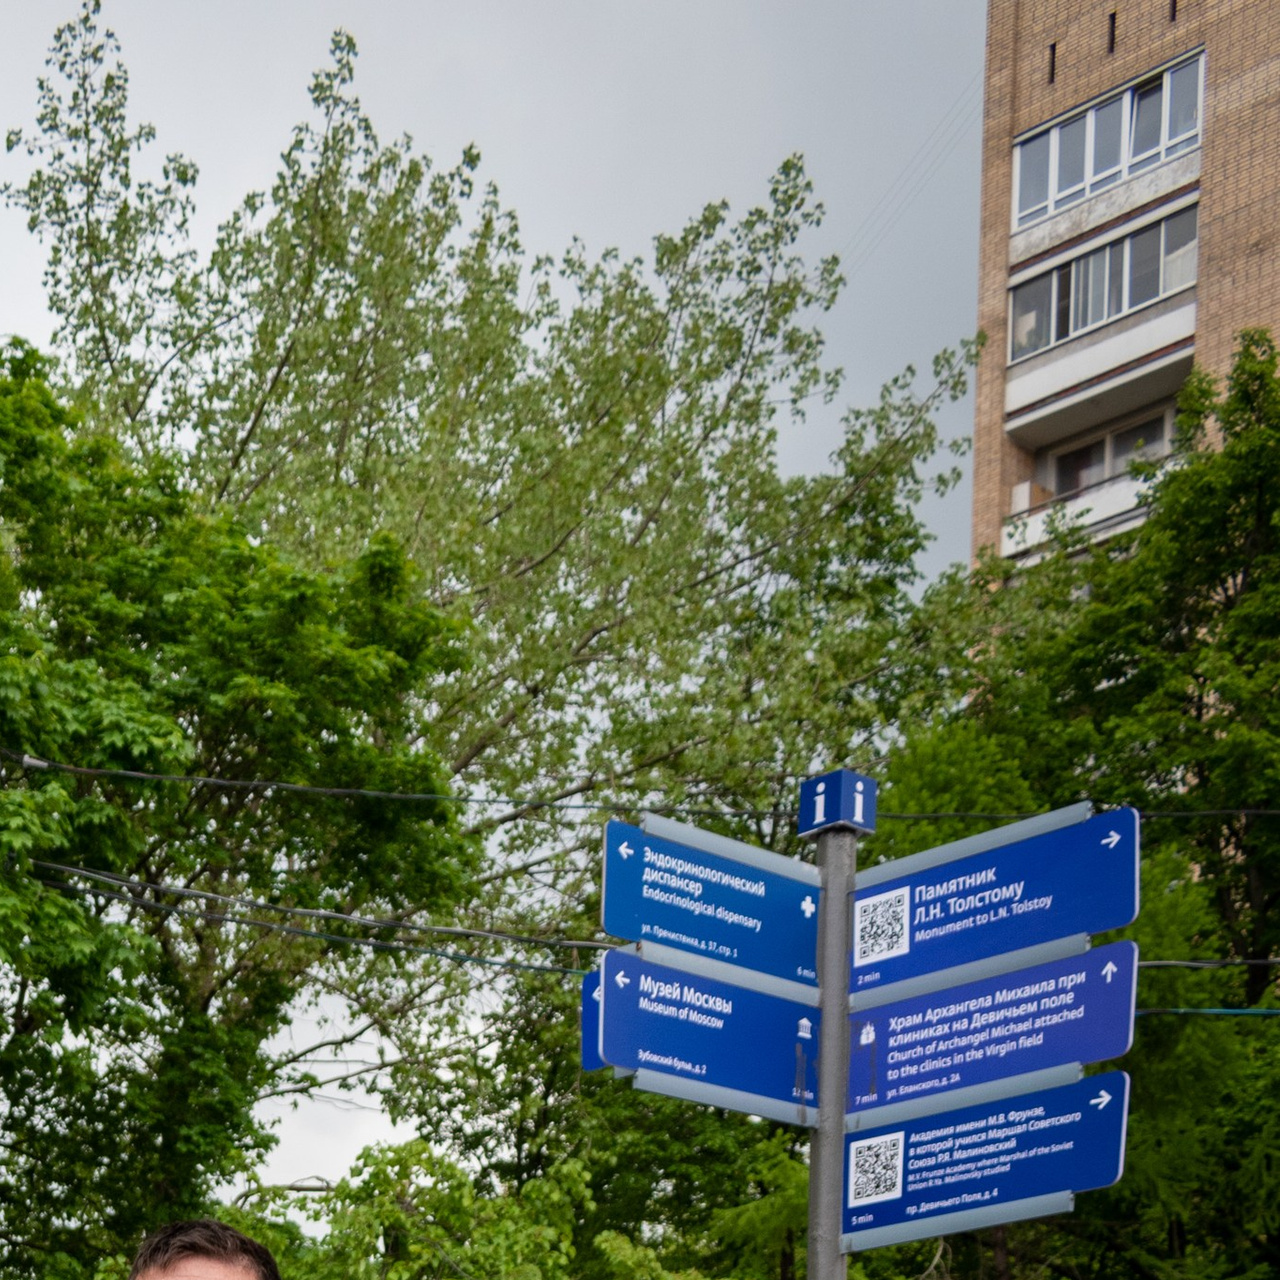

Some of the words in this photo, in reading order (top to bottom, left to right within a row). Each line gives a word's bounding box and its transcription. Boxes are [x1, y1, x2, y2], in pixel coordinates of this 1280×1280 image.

[642, 867, 703, 897] диспансер
[643, 846, 766, 897] Эндокринологический
[914, 867, 997, 904] Памятник
[642, 885, 715, 916] Endocrinological
[715, 906, 762, 932] dispensary
[913, 902, 945, 926] Л.Н.
[947, 880, 1025, 916] Толстому
[914, 914, 974, 942] Monument
[975, 912, 988, 926] to
[989, 905, 1010, 922] L.N.
[1011, 894, 1053, 917] Tolstoy
[641, 923, 652, 935] ул.
[803, 967, 816, 979] min
[857, 974, 863, 985] 2
[864, 971, 880, 984] min
[639, 974, 681, 1001] Музей
[683, 986, 732, 1014] Москвы
[888, 1012, 923, 1033] Храм
[924, 994, 993, 1023] Архангела
[994, 979, 1056, 1001] Михаила
[1057, 971, 1087, 992] при
[639, 997, 677, 1017] Museum
[678, 1008, 688, 1019] of
[689, 1011, 724, 1030] Moscow
[888, 1025, 950, 1048] клиниках
[952, 1018, 969, 1032] на
[970, 1001, 1038, 1030] Девичьем
[1040, 990, 1075, 1012] поле
[886, 1043, 924, 1064] Church
[925, 1041, 936, 1056] of
[937, 1028, 990, 1052] Archangel
[991, 1016, 1033, 1039] Michael
[1034, 1004, 1085, 1028] attached
[638, 1049, 673, 1066] Зубовский
[886, 1067, 899, 1081] to
[900, 1062, 918, 1077] the
[919, 1055, 952, 1073] clinics
[953, 1051, 964, 1064] in
[965, 1047, 984, 1062] the
[984, 1040, 1017, 1059] Virgin
[1018, 1032, 1043, 1050] field
[855, 1093, 862, 1105] 7
[862, 1091, 878, 1103] min
[886, 1085, 898, 1100] ул.
[908, 1126, 955, 1143] Академия
[955, 1119, 987, 1133] имени
[987, 1113, 1006, 1125] М.В.
[1007, 1106, 1046, 1122] Фрунзе,
[908, 1148, 915, 1157] в
[916, 1138, 953, 1156] которой
[954, 1131, 986, 1149] учился
[987, 1123, 1027, 1140] Маршал
[1028, 1111, 1081, 1131] Советского
[908, 1156, 936, 1170] Союза
[952, 1137, 1017, 1160] Малиновский
[921, 1168, 945, 1179] Frunze
[945, 1157, 976, 1174] Academy
[976, 1157, 998, 1168] where
[999, 1149, 1028, 1162] Marshal
[1028, 1147, 1037, 1157] of
[1037, 1145, 1050, 1155] the
[1050, 1140, 1074, 1153] Soviet
[907, 1181, 928, 1192] Union
[944, 1169, 982, 1184] Malinovsky
[983, 1162, 1011, 1176] studied
[851, 1215, 858, 1225] 5
[858, 1213, 874, 1223] min
[905, 1204, 918, 1216] пр.
[918, 1196, 961, 1213] Девичьего
[992, 1188, 999, 1197] 4
